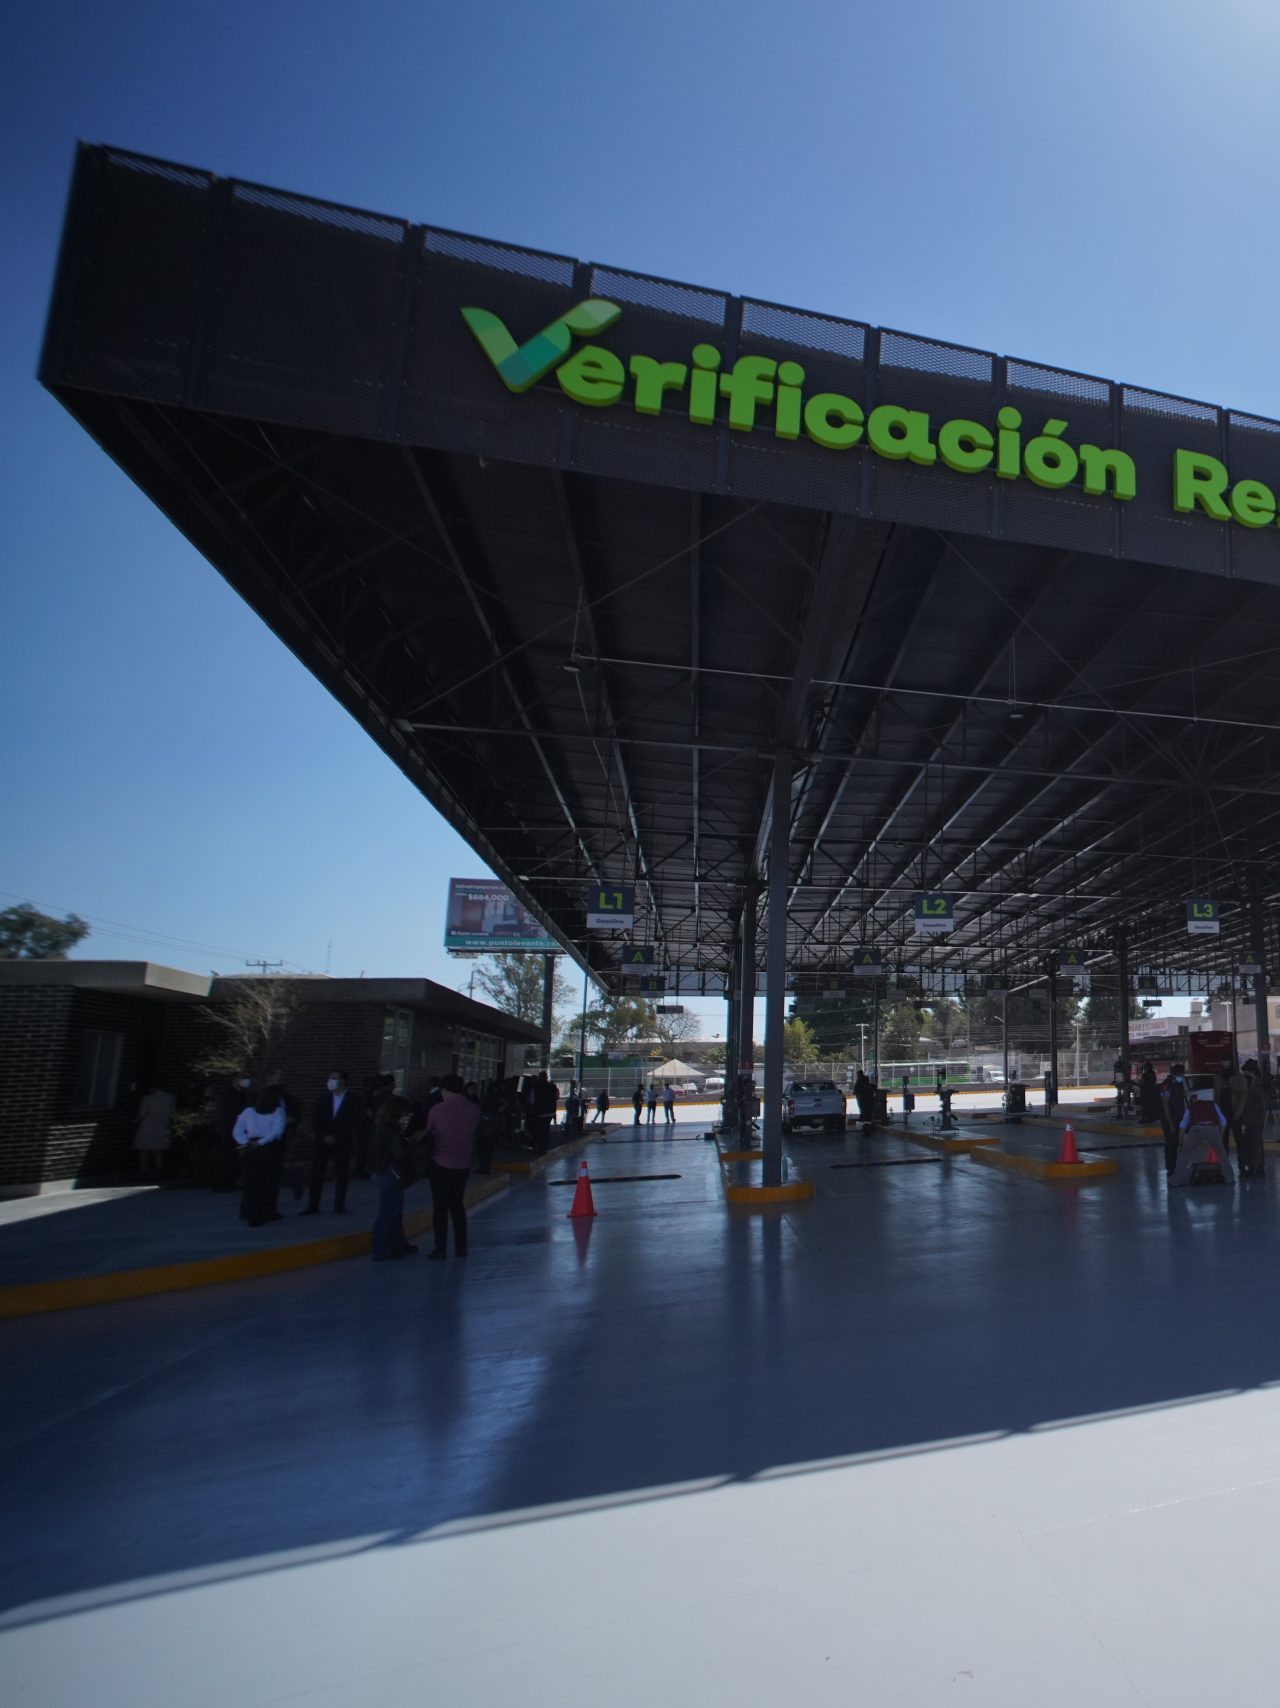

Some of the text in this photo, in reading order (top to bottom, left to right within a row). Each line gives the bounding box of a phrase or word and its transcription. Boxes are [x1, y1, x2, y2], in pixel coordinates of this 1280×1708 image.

[460, 298, 1137, 501] Verificación
[599, 892, 623, 909] L1
[922, 898, 947, 915] L2
[1193, 903, 1214, 918] L3
[631, 951, 645, 963] A
